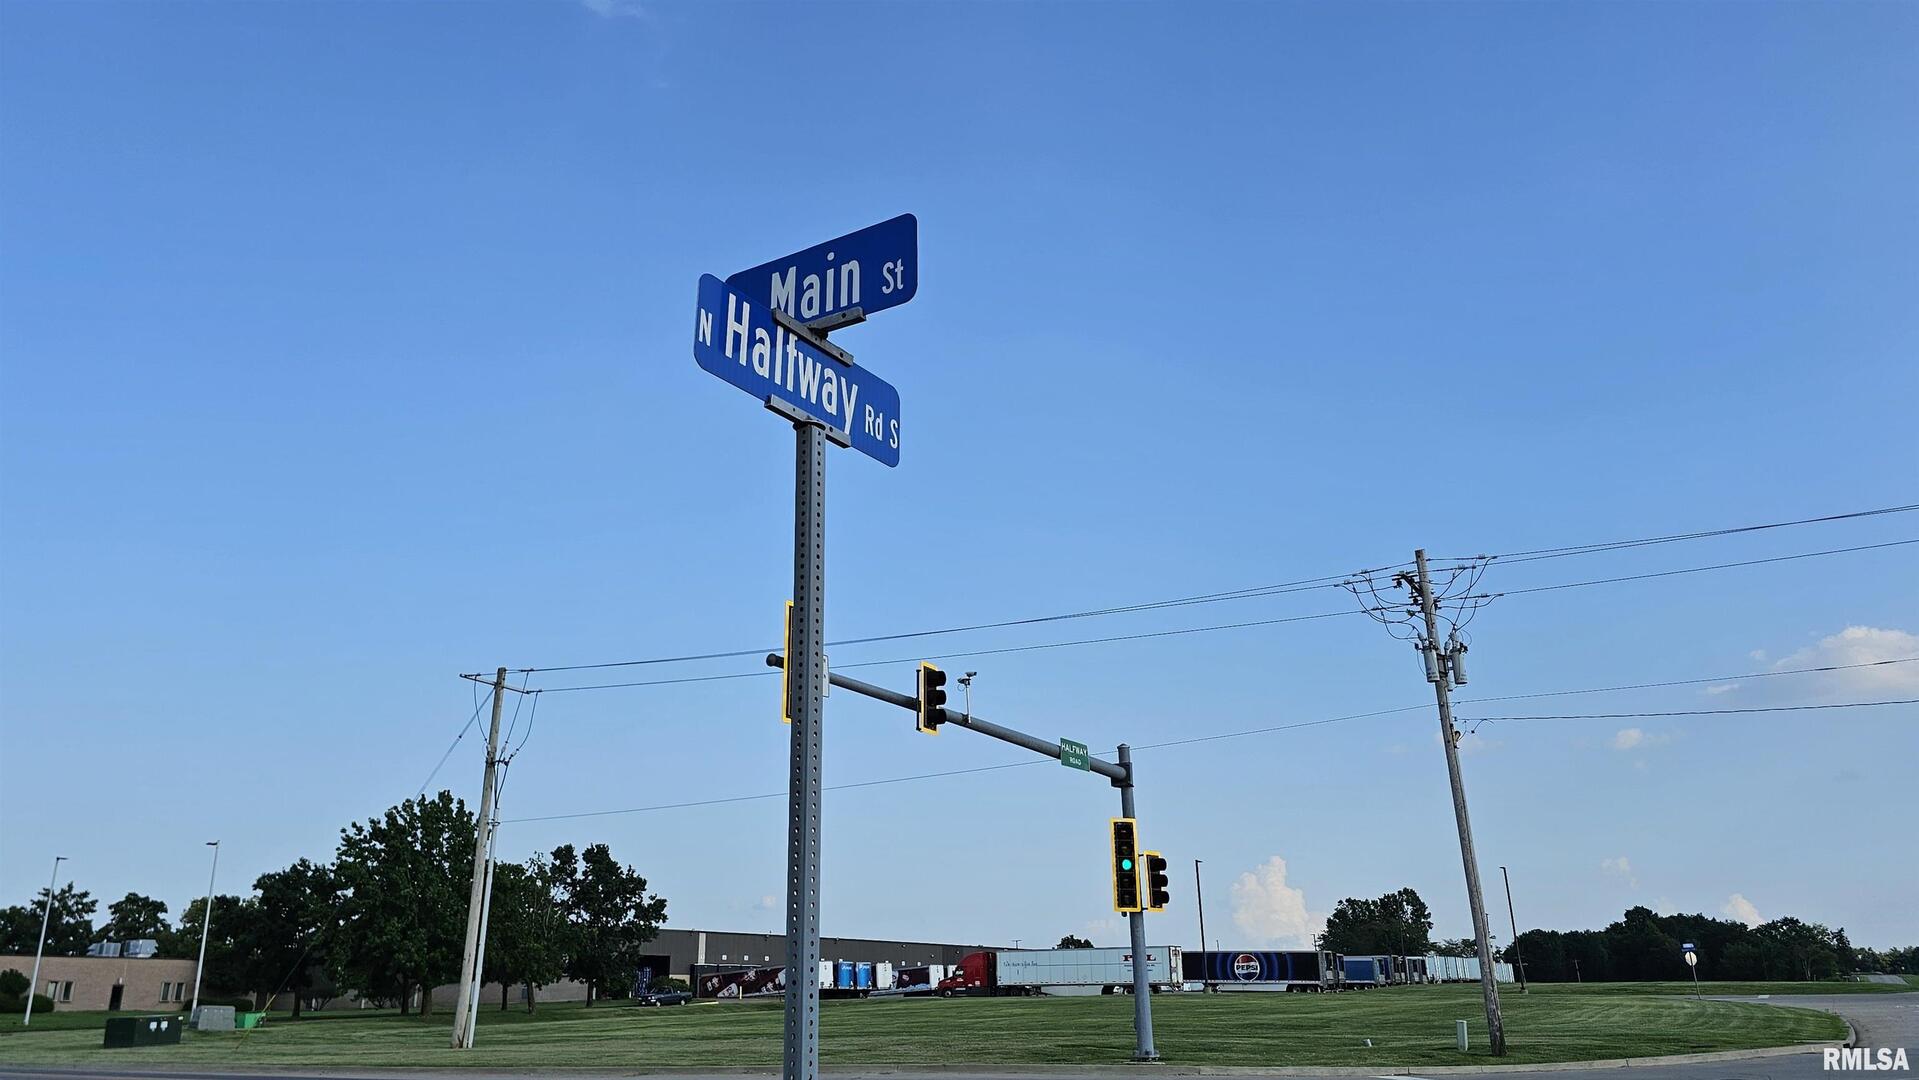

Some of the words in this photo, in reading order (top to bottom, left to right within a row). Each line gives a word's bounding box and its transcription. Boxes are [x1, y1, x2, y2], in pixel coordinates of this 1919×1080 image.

[771, 252, 860, 319] Main
[881, 258, 904, 294] St
[698, 308, 713, 347] N
[725, 293, 858, 434] Halfway
[865, 404, 883, 441] Rd
[889, 419, 899, 449] S
[1061, 742, 1087, 757] HALFWAY
